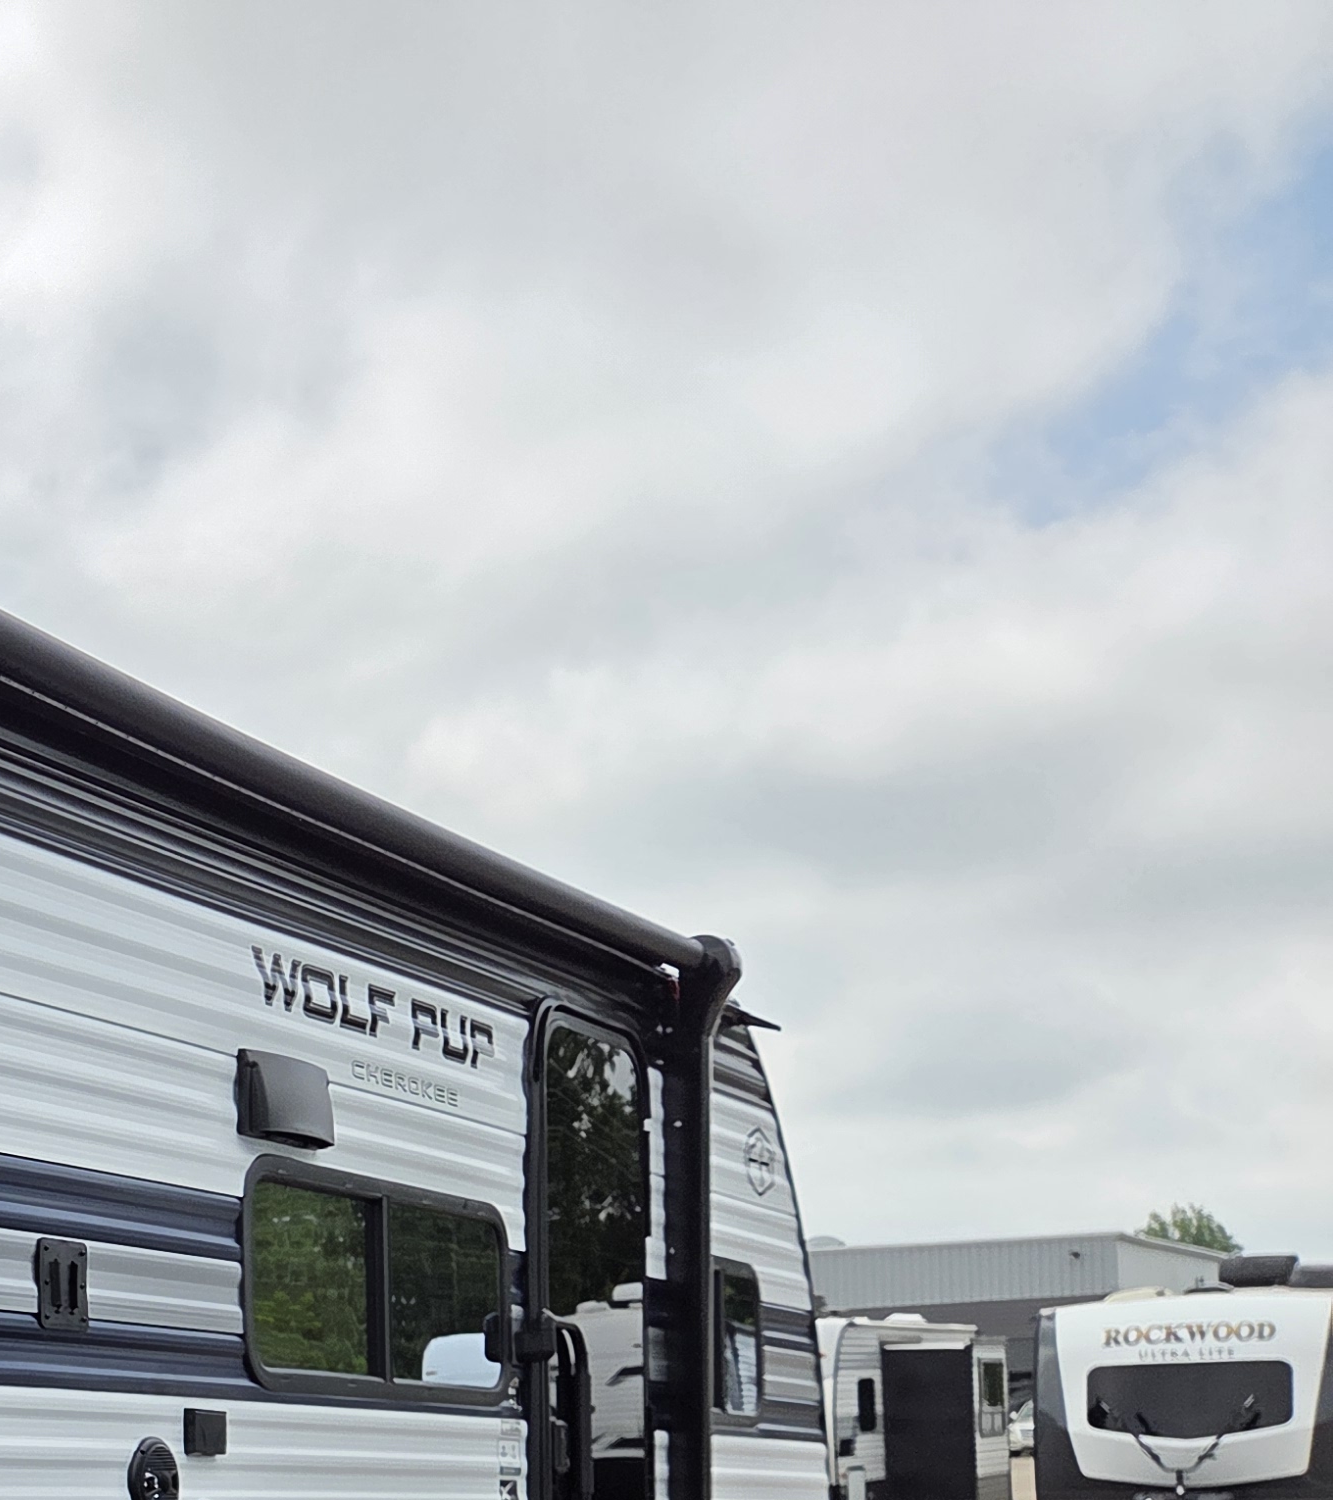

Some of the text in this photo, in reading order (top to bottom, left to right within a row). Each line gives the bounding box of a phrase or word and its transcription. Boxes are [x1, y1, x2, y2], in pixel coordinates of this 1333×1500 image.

[251, 945, 495, 1069] WOLF PUP
[351, 1059, 458, 1107] CHEROKEE
[1102, 1320, 1276, 1348] ROCKWOOD
